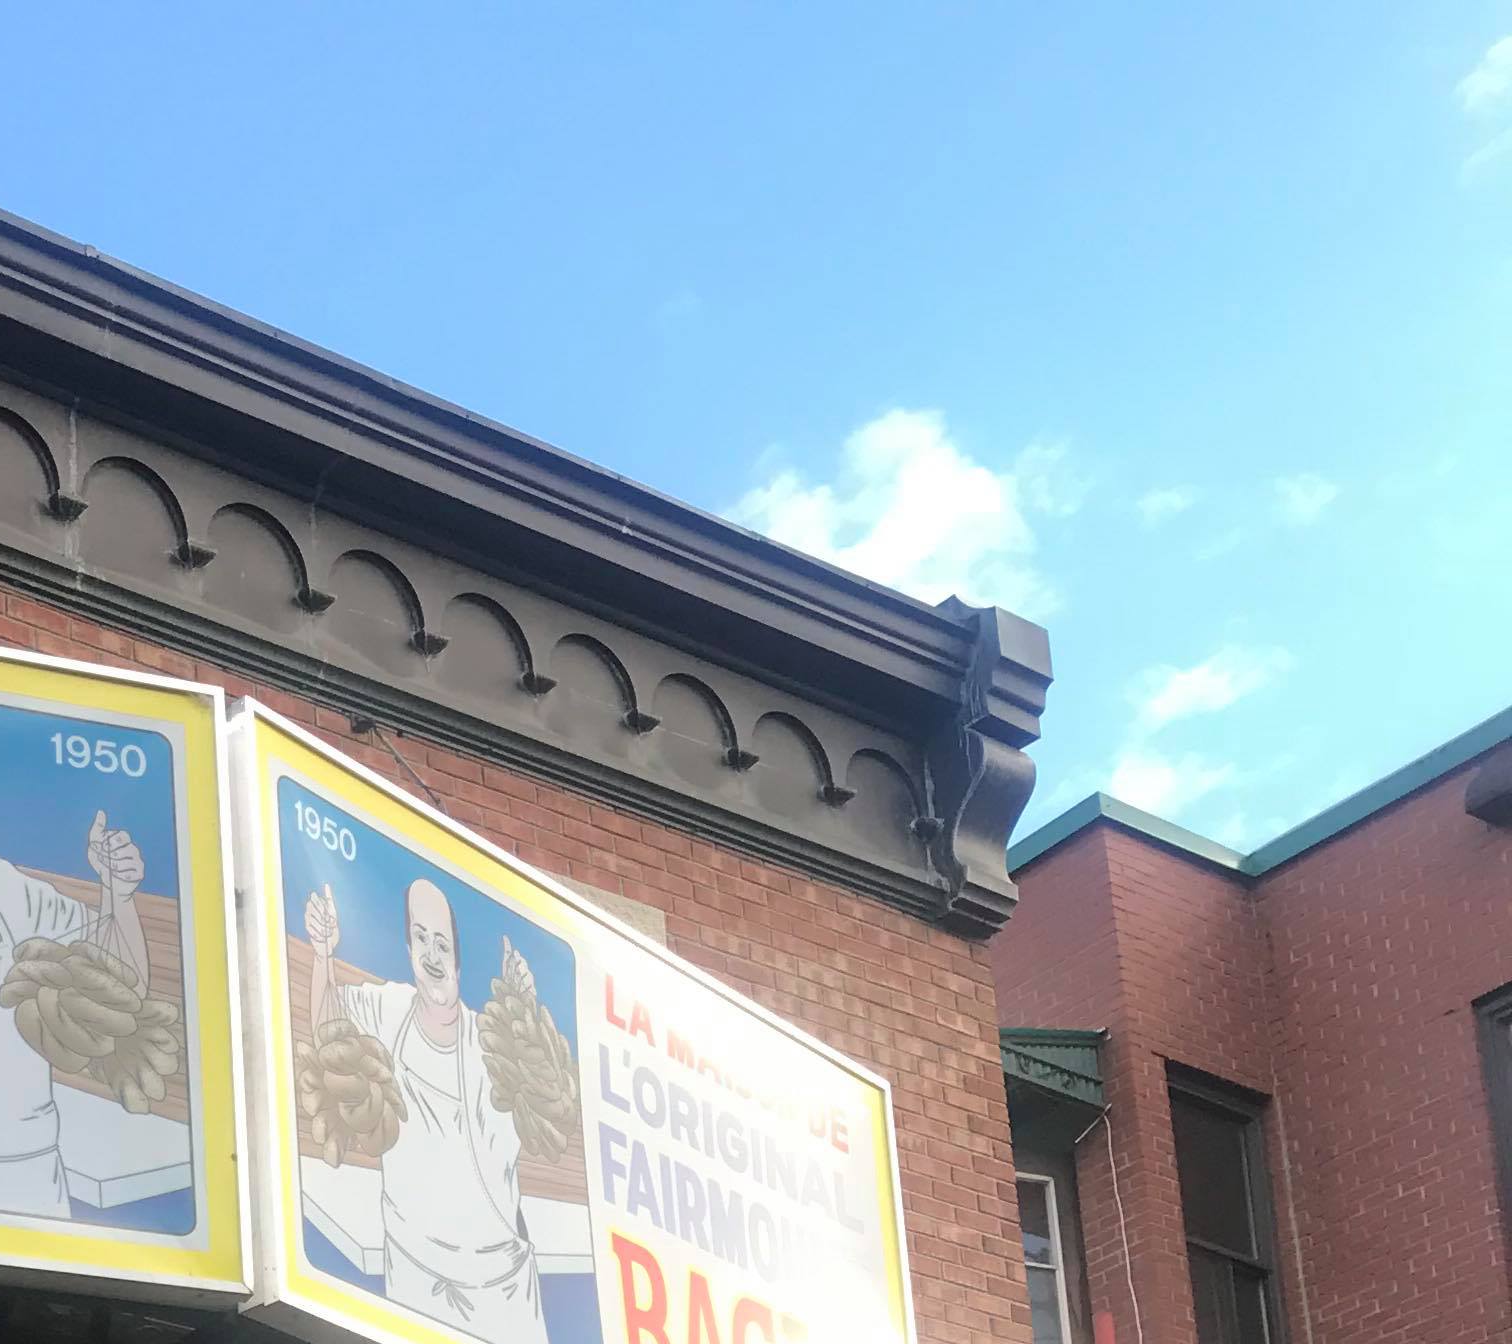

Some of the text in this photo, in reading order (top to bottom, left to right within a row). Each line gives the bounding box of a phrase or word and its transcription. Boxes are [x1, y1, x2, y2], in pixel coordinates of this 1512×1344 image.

[50, 732, 147, 777] 1950
[294, 799, 357, 861] 1950
[605, 973, 657, 1049] LA
[597, 1041, 866, 1236] L'ORIGINAL
